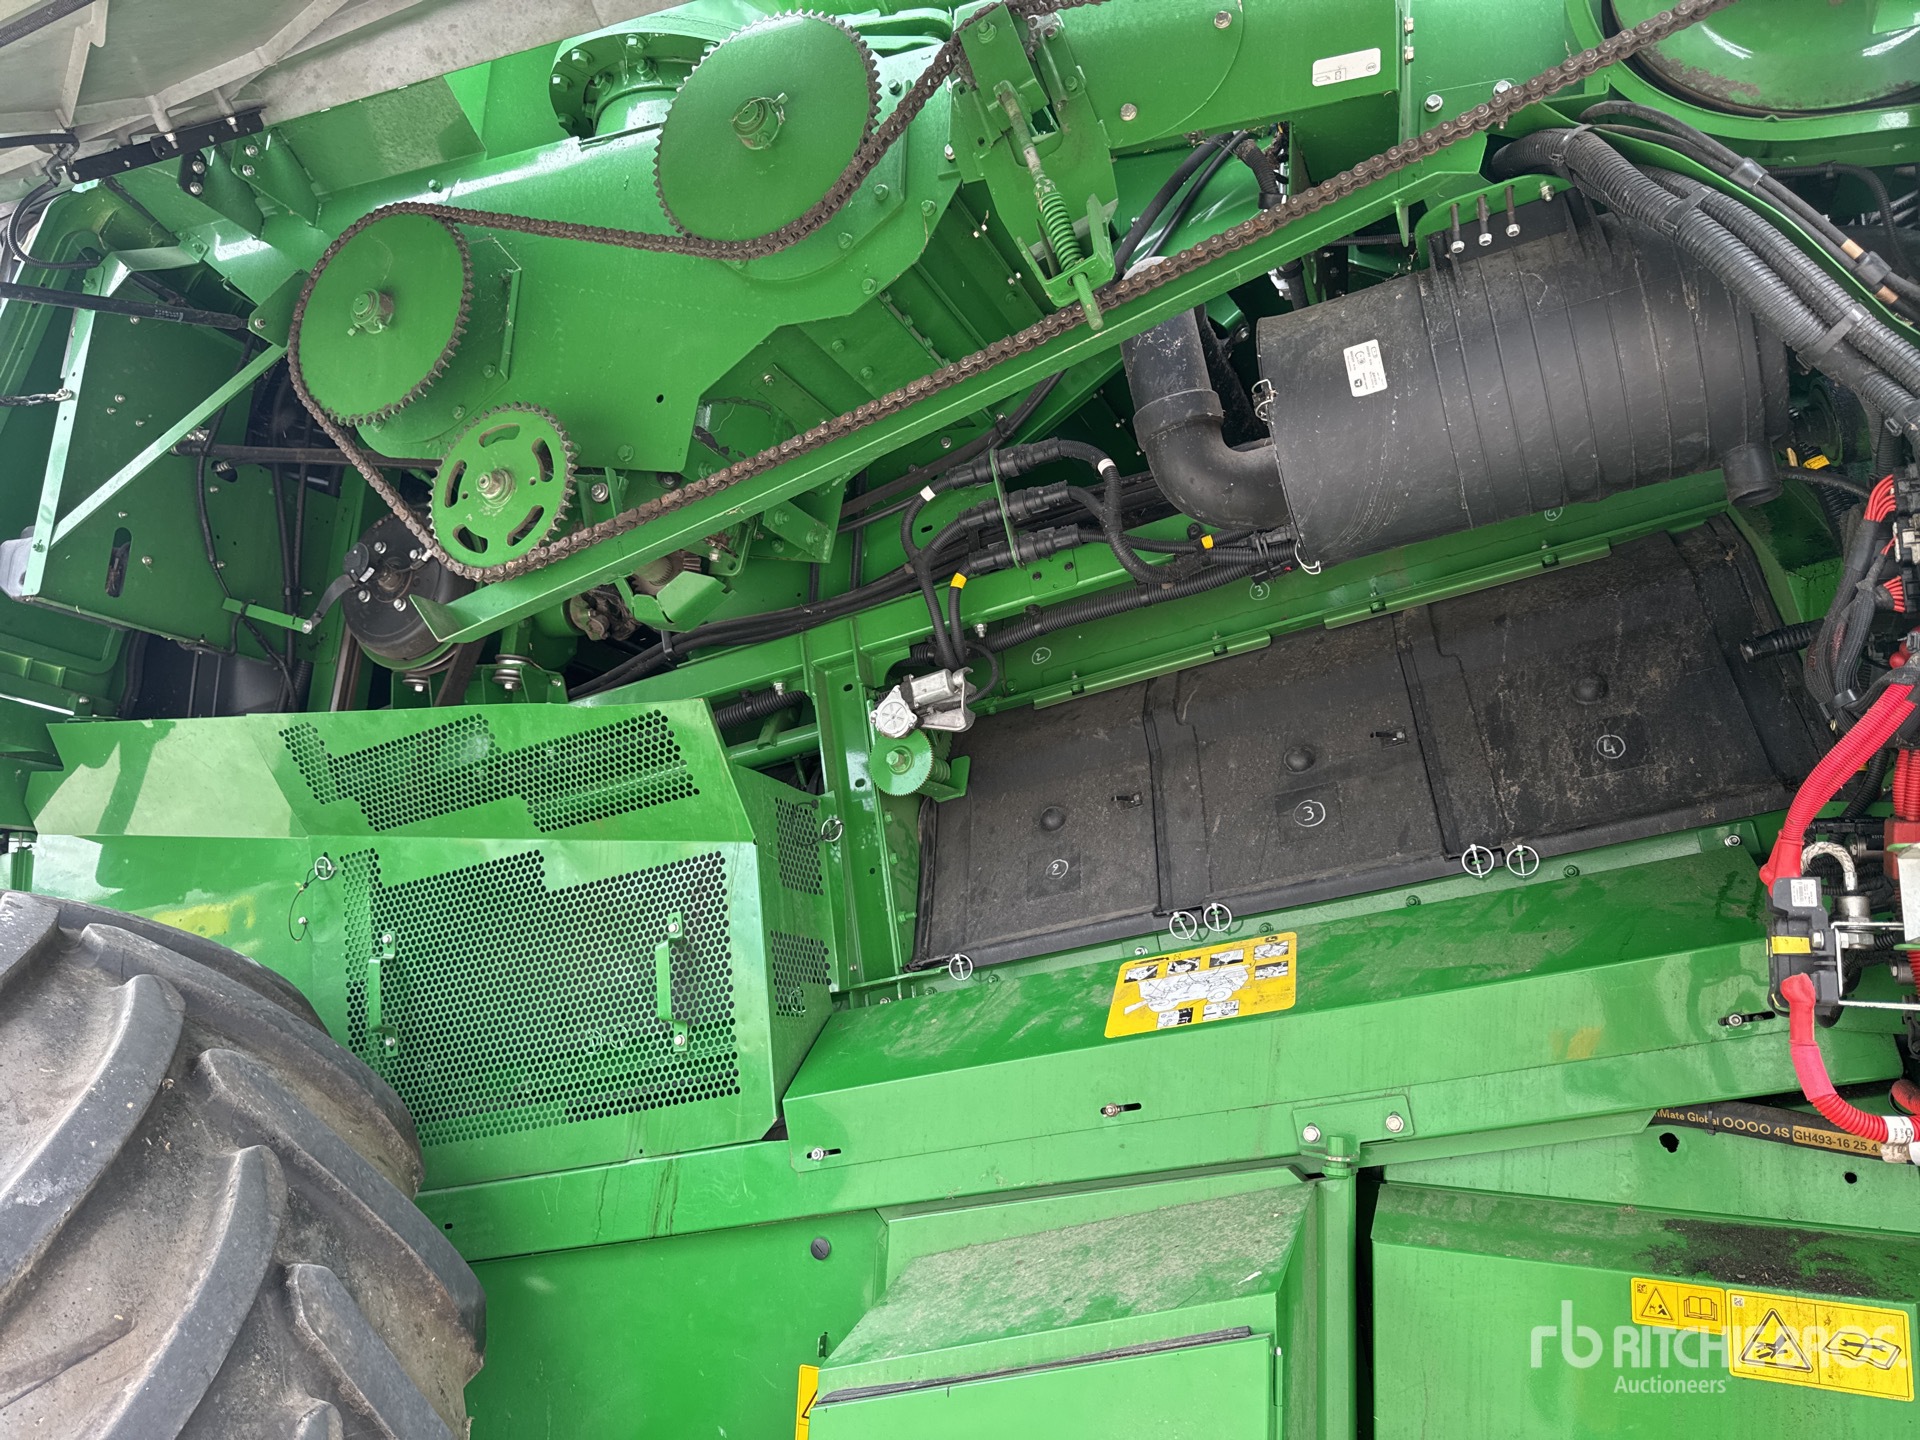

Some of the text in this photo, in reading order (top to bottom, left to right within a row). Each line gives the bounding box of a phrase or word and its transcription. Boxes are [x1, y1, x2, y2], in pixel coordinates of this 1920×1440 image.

[1773, 1127, 1790, 1138] 4S
[1794, 1130, 1850, 1149] GH493-16
[1853, 1140, 1879, 1153] 25.4
